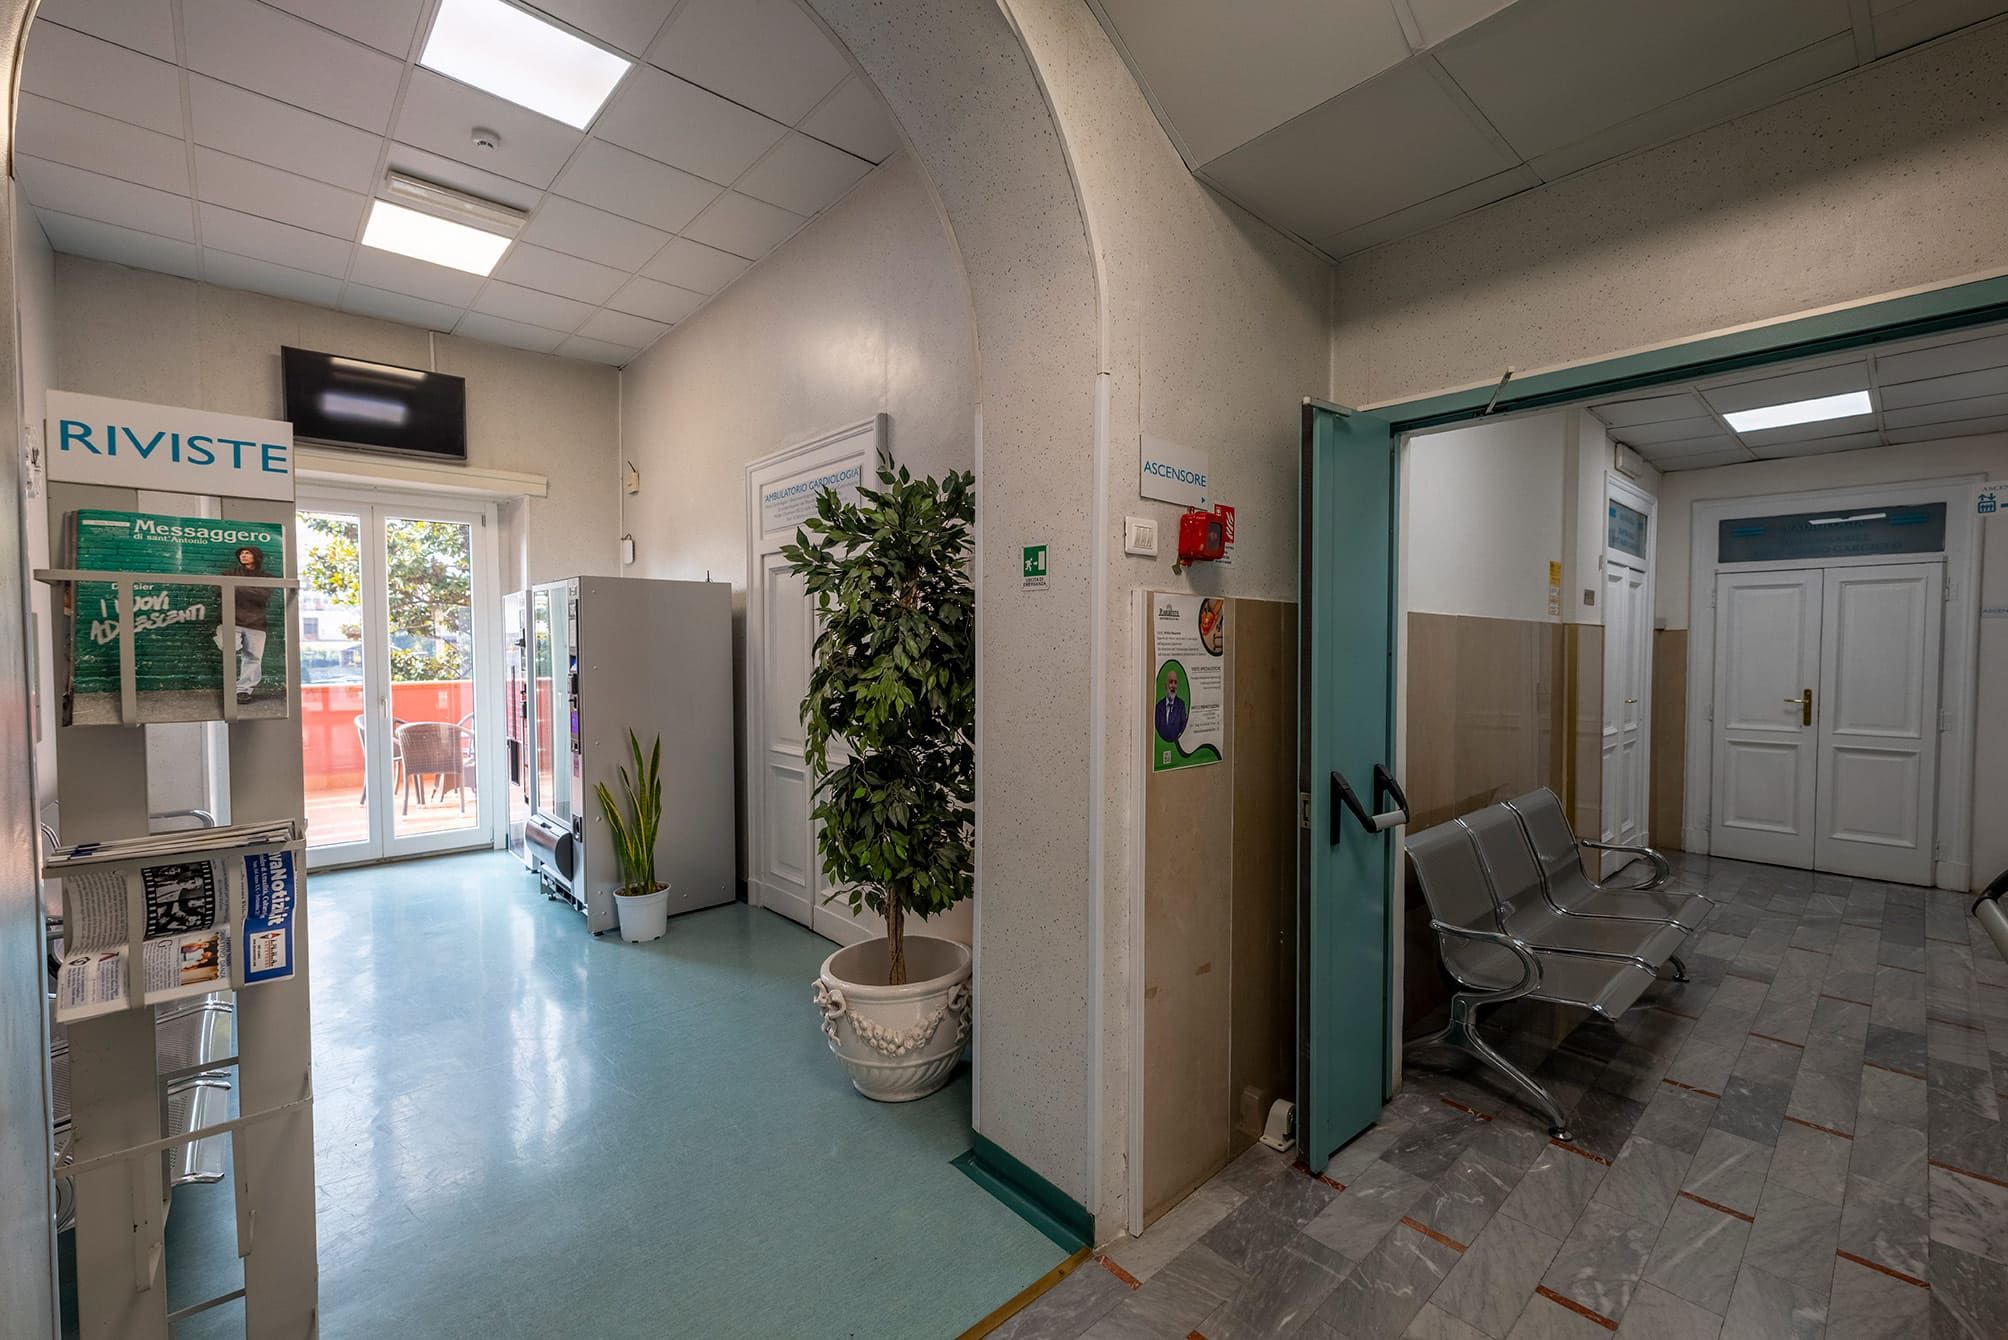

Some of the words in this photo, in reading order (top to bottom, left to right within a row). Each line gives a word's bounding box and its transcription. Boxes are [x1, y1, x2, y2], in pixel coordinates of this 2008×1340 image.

[59, 420, 289, 474] RIVISTE
[765, 483, 808, 502] AMBULATORIO
[808, 468, 859, 490] CARDIOLOGIA
[1143, 460, 1207, 488] ASCENSORE
[134, 519, 271, 544] Messaggero
[146, 535, 209, 545] sant'Antonio
[115, 591, 169, 616] UOVI
[90, 603, 206, 645] ADESCENTI
